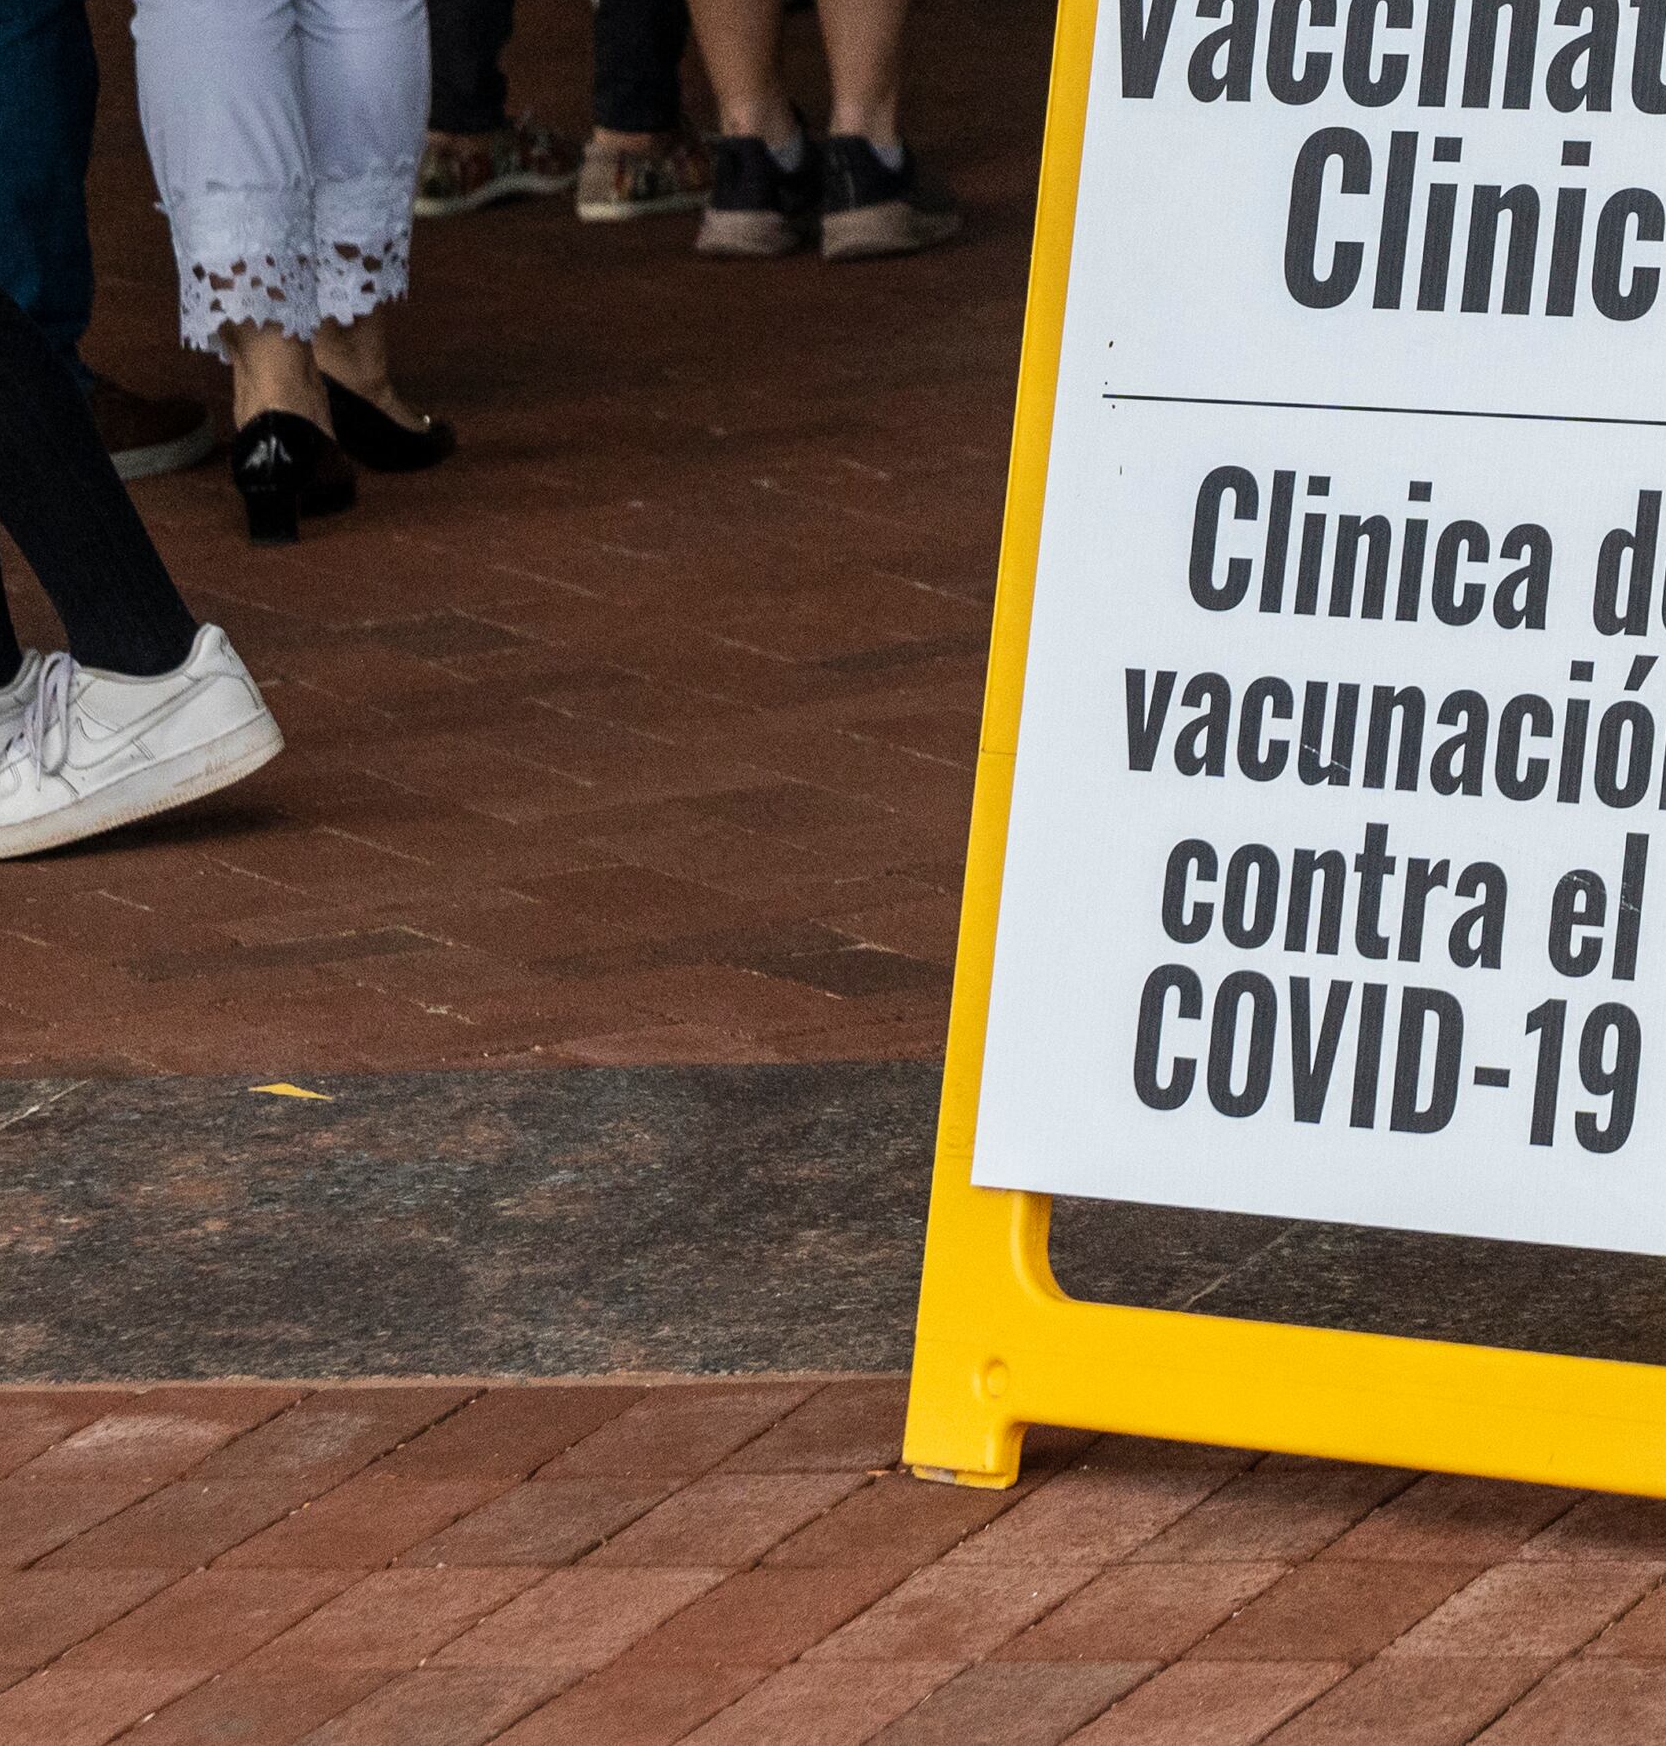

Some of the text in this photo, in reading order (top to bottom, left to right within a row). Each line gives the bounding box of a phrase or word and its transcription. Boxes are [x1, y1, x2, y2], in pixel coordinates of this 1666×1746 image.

[1284, 126, 1666, 322] Clinic
[1187, 464, 1554, 632] Clinica
[1161, 824, 1648, 981] contra el
[1133, 964, 1642, 1154] COVID-19
